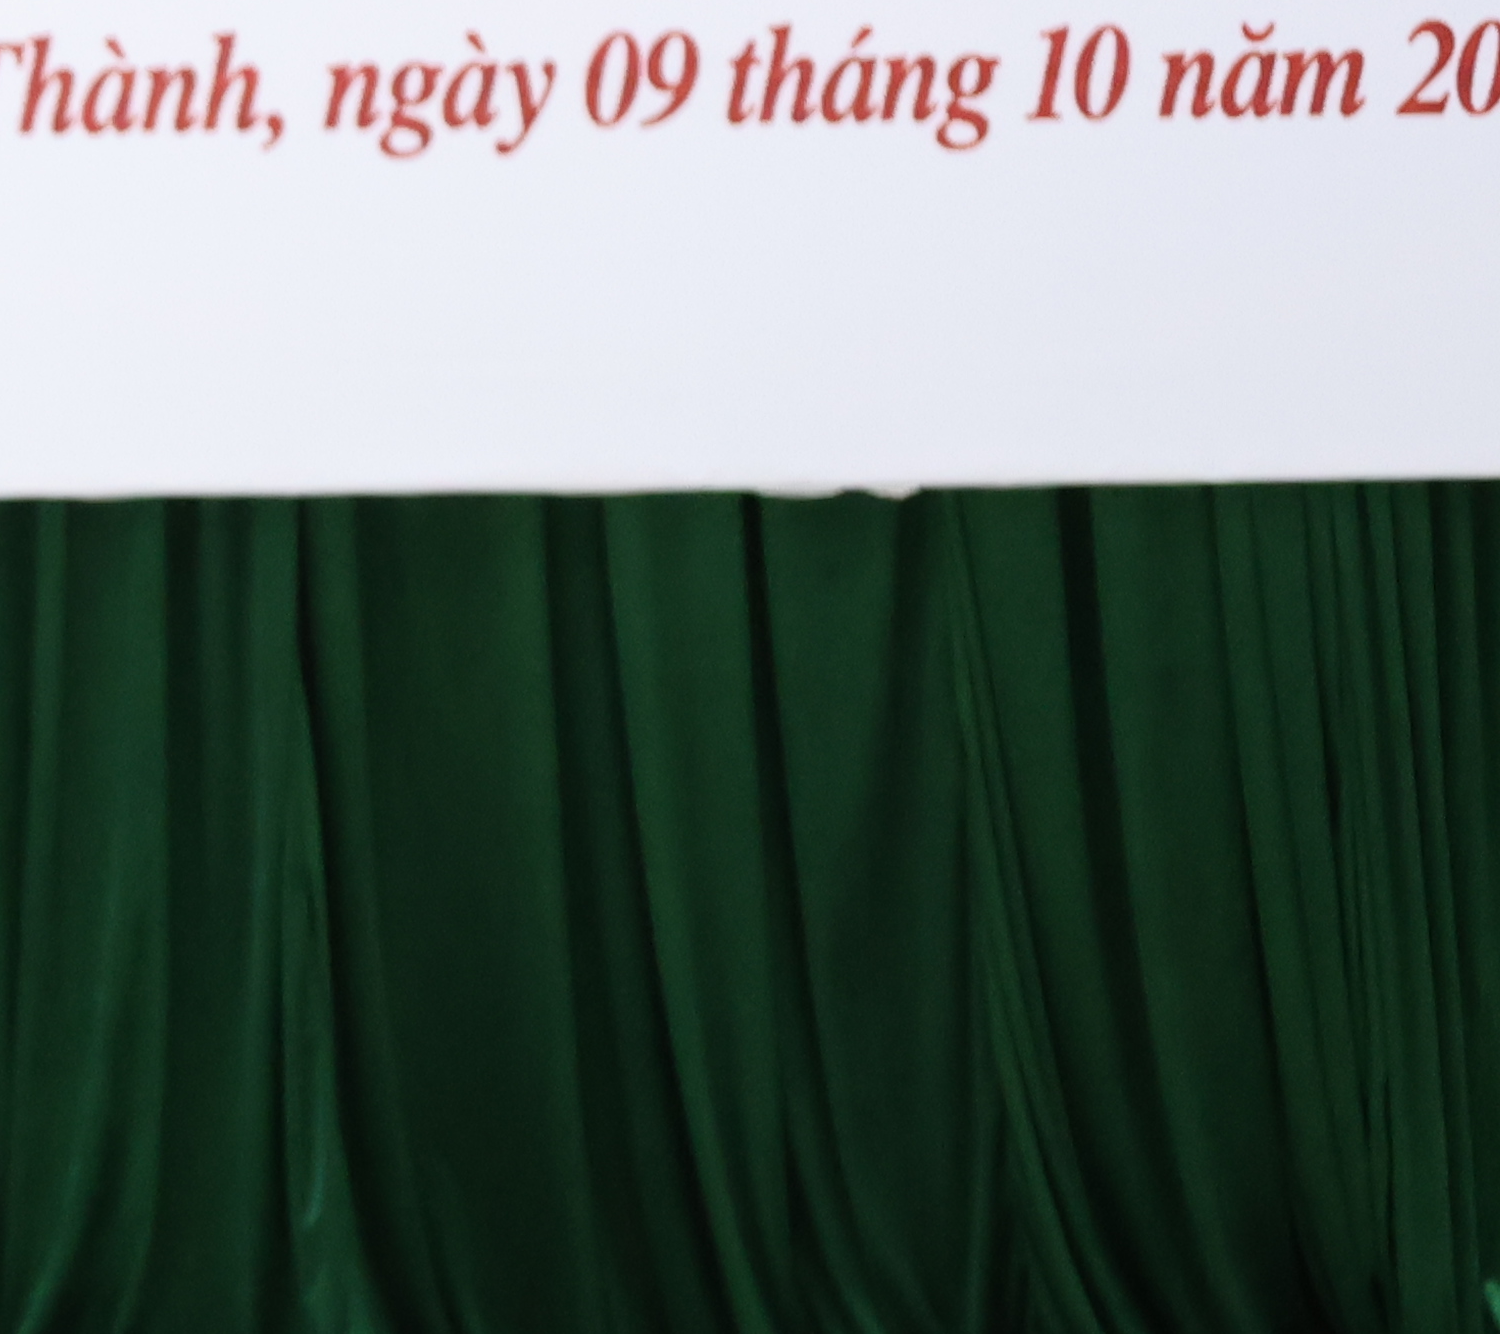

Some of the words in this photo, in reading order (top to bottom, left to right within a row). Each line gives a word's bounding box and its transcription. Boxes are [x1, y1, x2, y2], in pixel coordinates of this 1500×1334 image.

[326, 34, 556, 156] ngày
[585, 34, 699, 125] 09
[727, 27, 989, 149] tháng
[1032, 26, 1131, 120] 10
[1159, 23, 1365, 119] năm
[1397, 19, 1500, 116] 20
